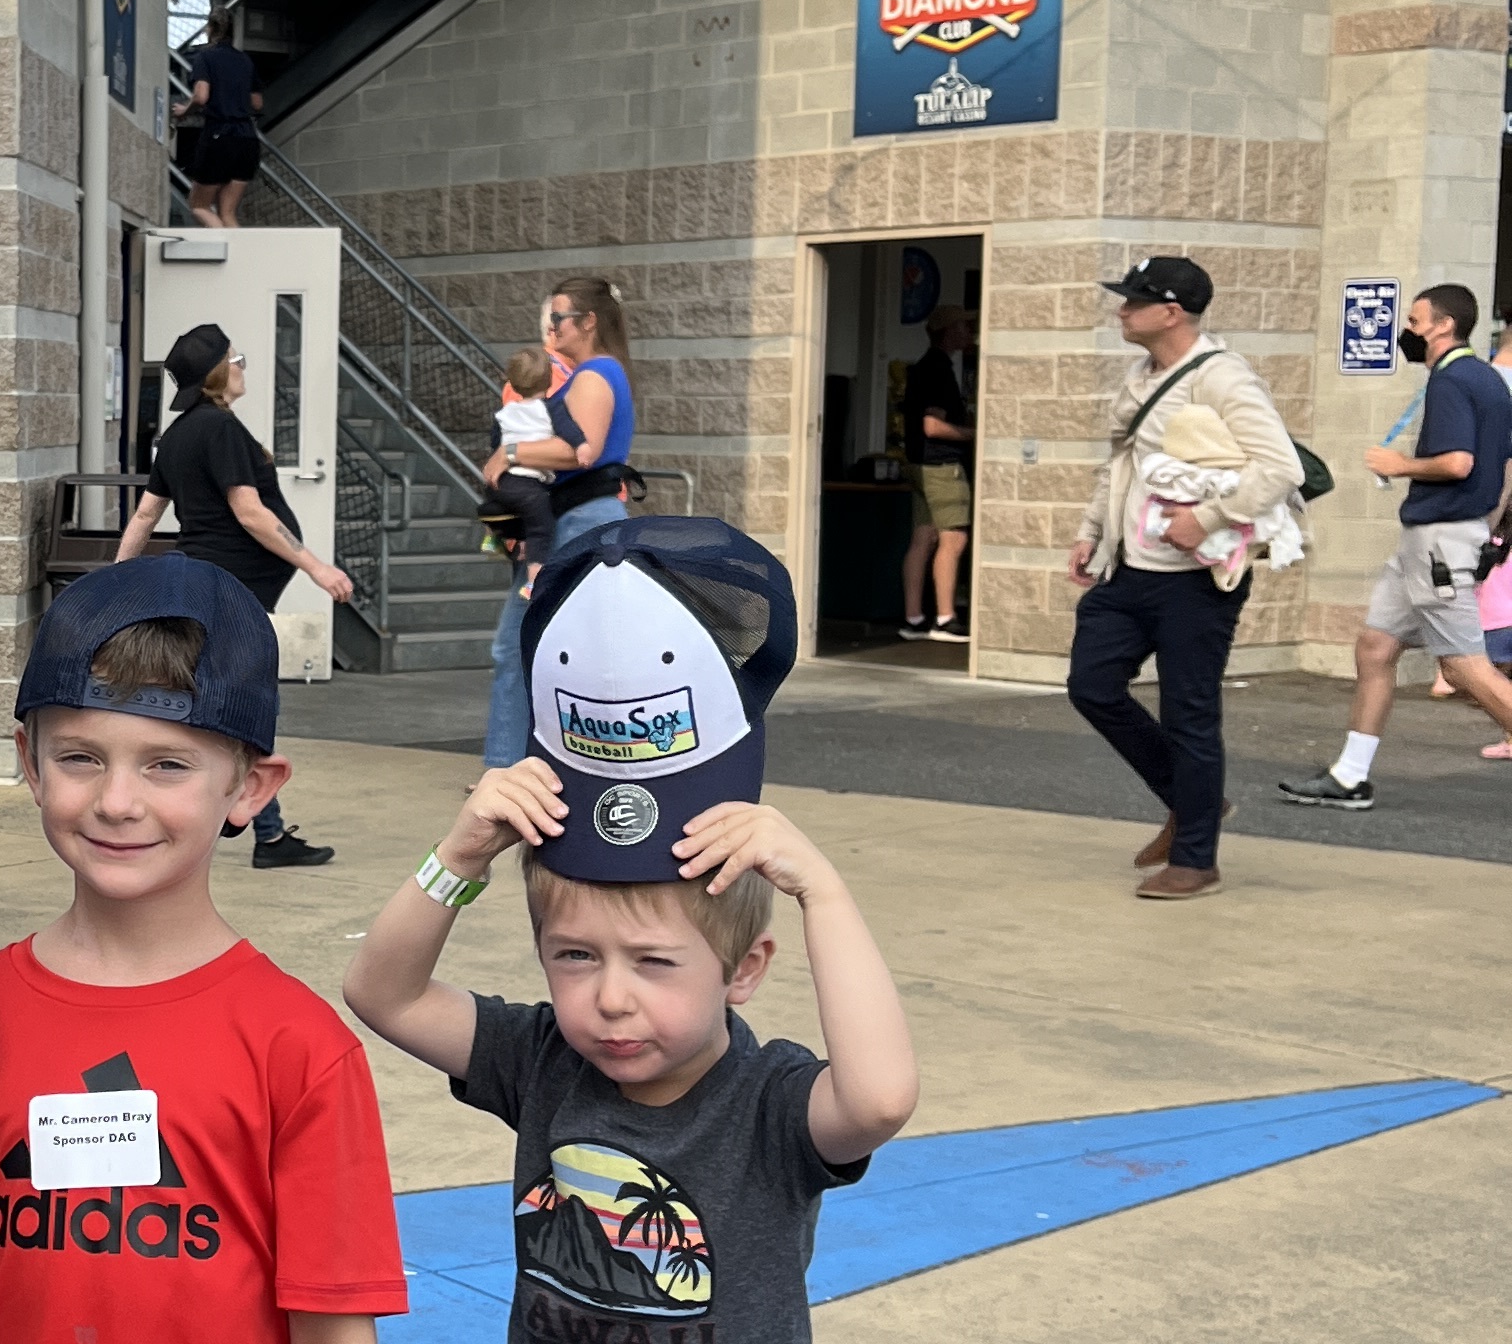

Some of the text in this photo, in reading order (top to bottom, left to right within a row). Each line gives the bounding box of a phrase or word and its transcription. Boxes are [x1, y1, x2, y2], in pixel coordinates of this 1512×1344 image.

[938, 20, 972, 40] CLUB
[914, 87, 993, 113] TULALIP
[569, 736, 634, 758] baseball
[38, 1112, 153, 1127] Mr. Cameron Bray
[52, 1131, 137, 1148] Sponsor DAG
